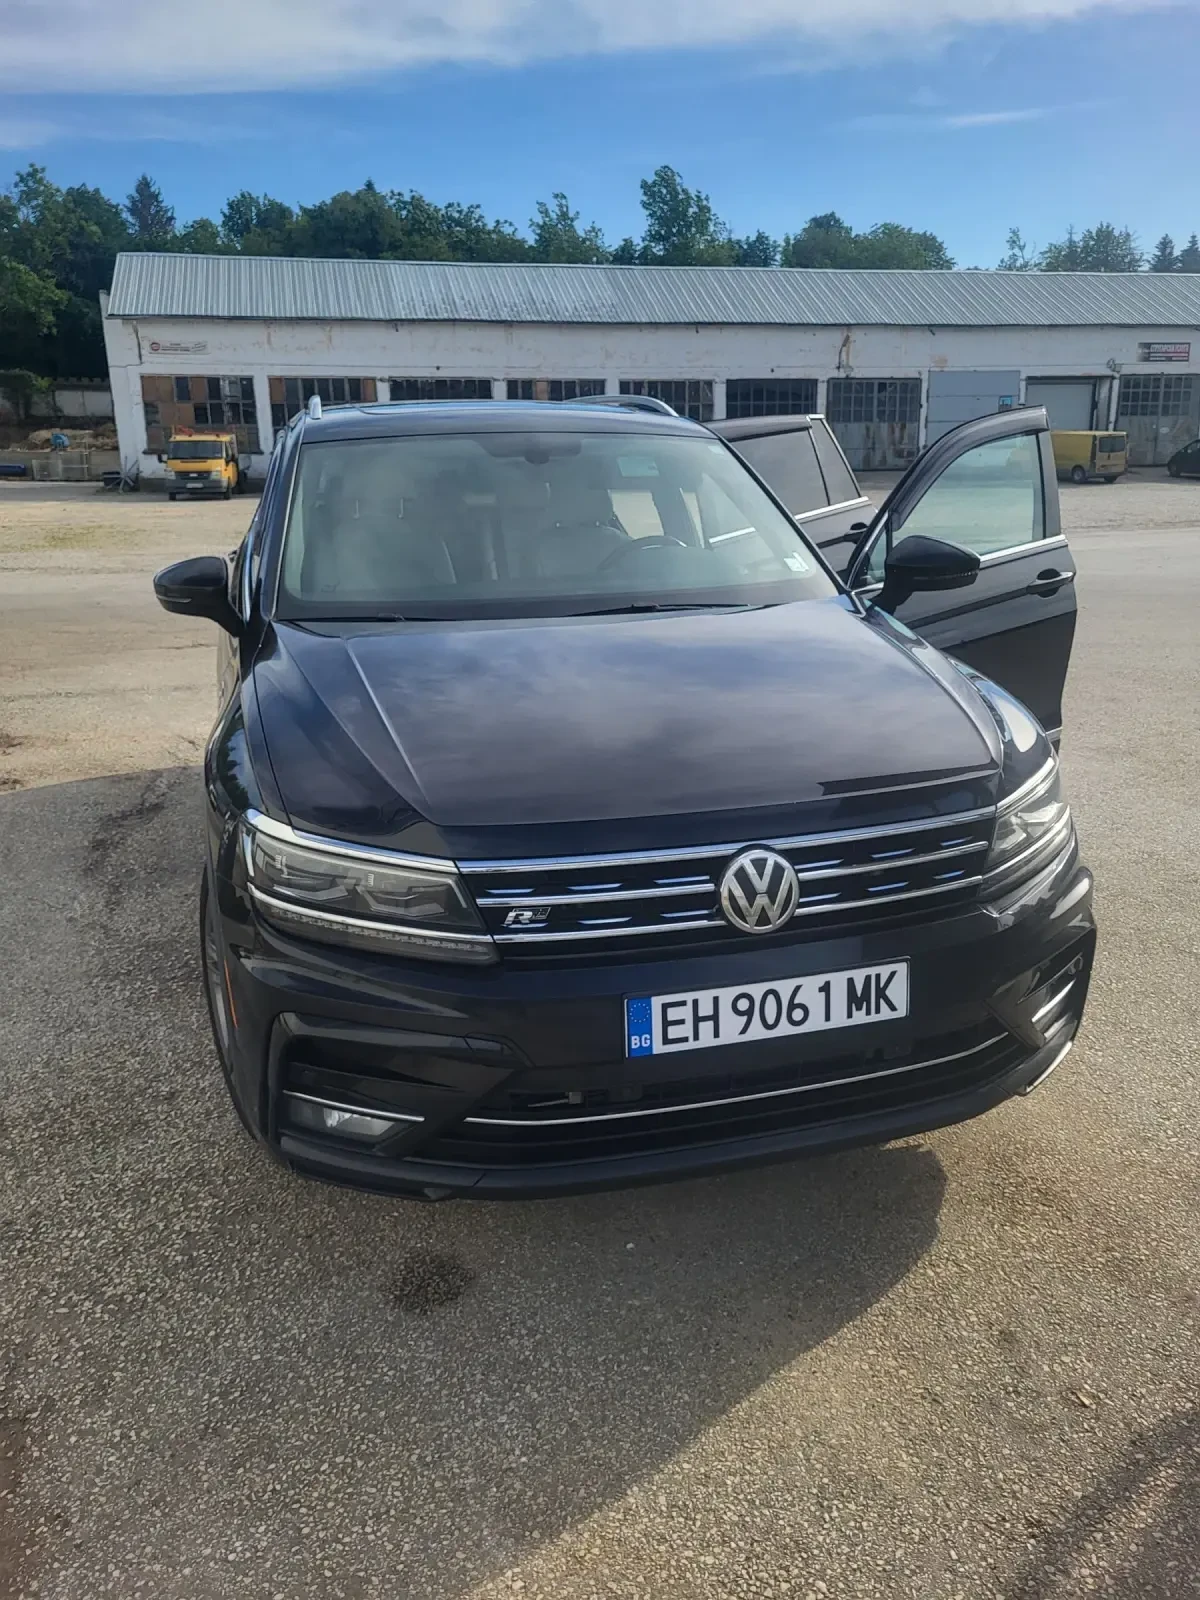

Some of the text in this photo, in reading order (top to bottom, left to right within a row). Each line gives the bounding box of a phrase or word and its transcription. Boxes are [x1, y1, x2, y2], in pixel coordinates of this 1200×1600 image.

[721, 851, 798, 932] VW
[631, 1034, 651, 1049] BG
[661, 970, 898, 1046] EH 9061 MK
